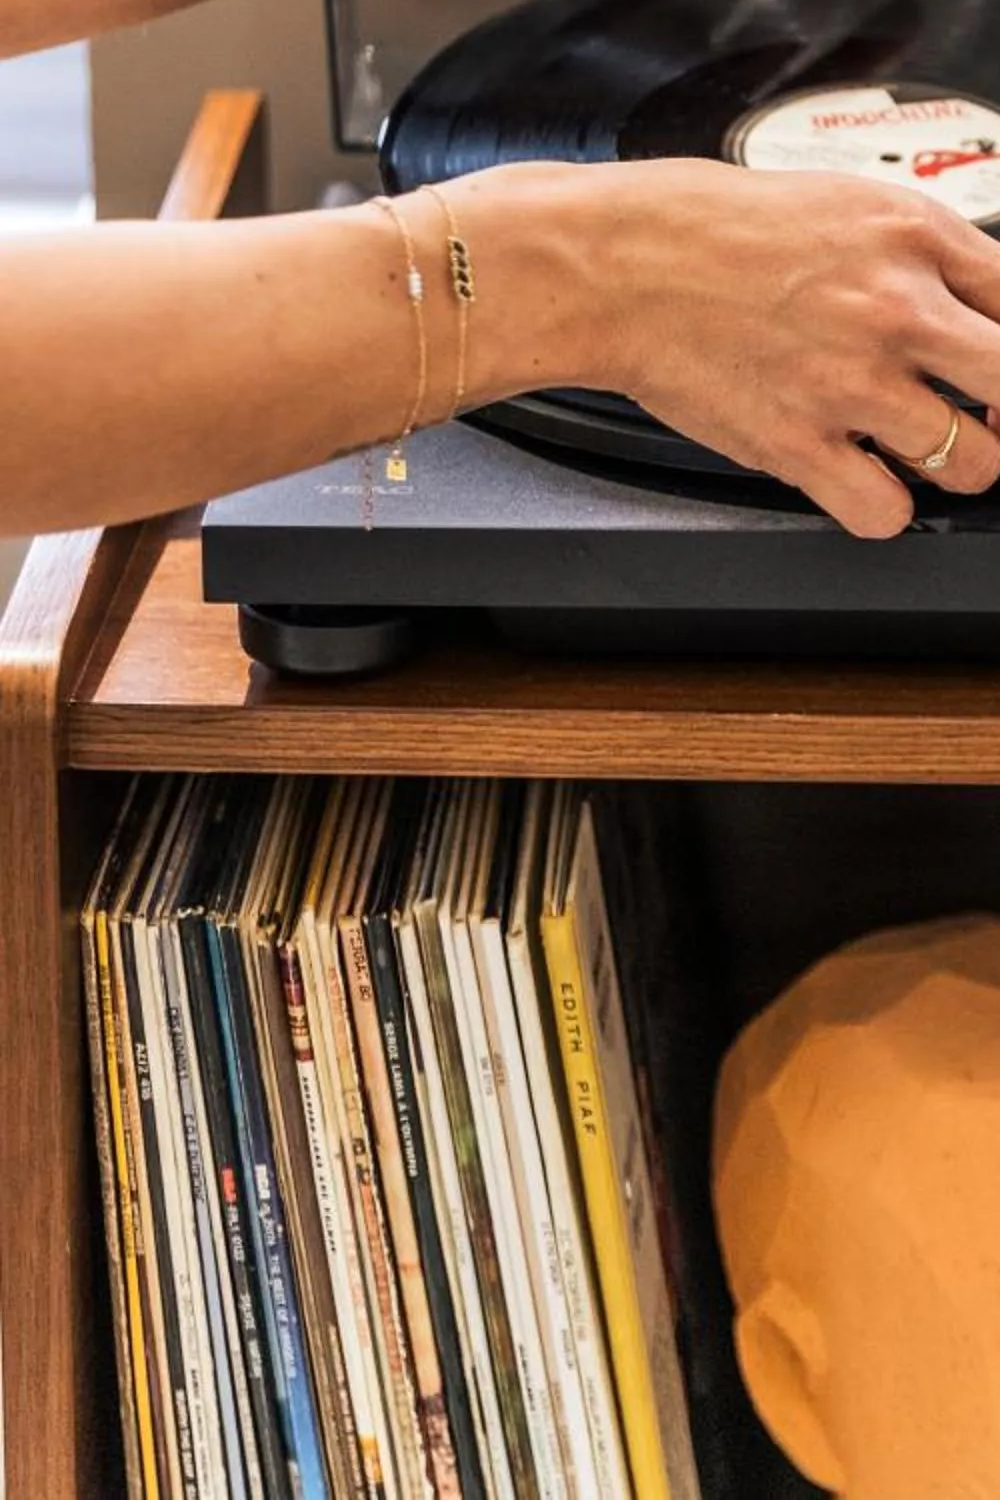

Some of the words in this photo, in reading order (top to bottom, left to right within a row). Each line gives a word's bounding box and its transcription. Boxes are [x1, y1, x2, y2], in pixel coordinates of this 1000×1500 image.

[384, 1022, 399, 1062] SERGE
[560, 981, 583, 1053] EDITH
[576, 1080, 597, 1136] PIAF
[391, 1064, 405, 1100] LAMA
